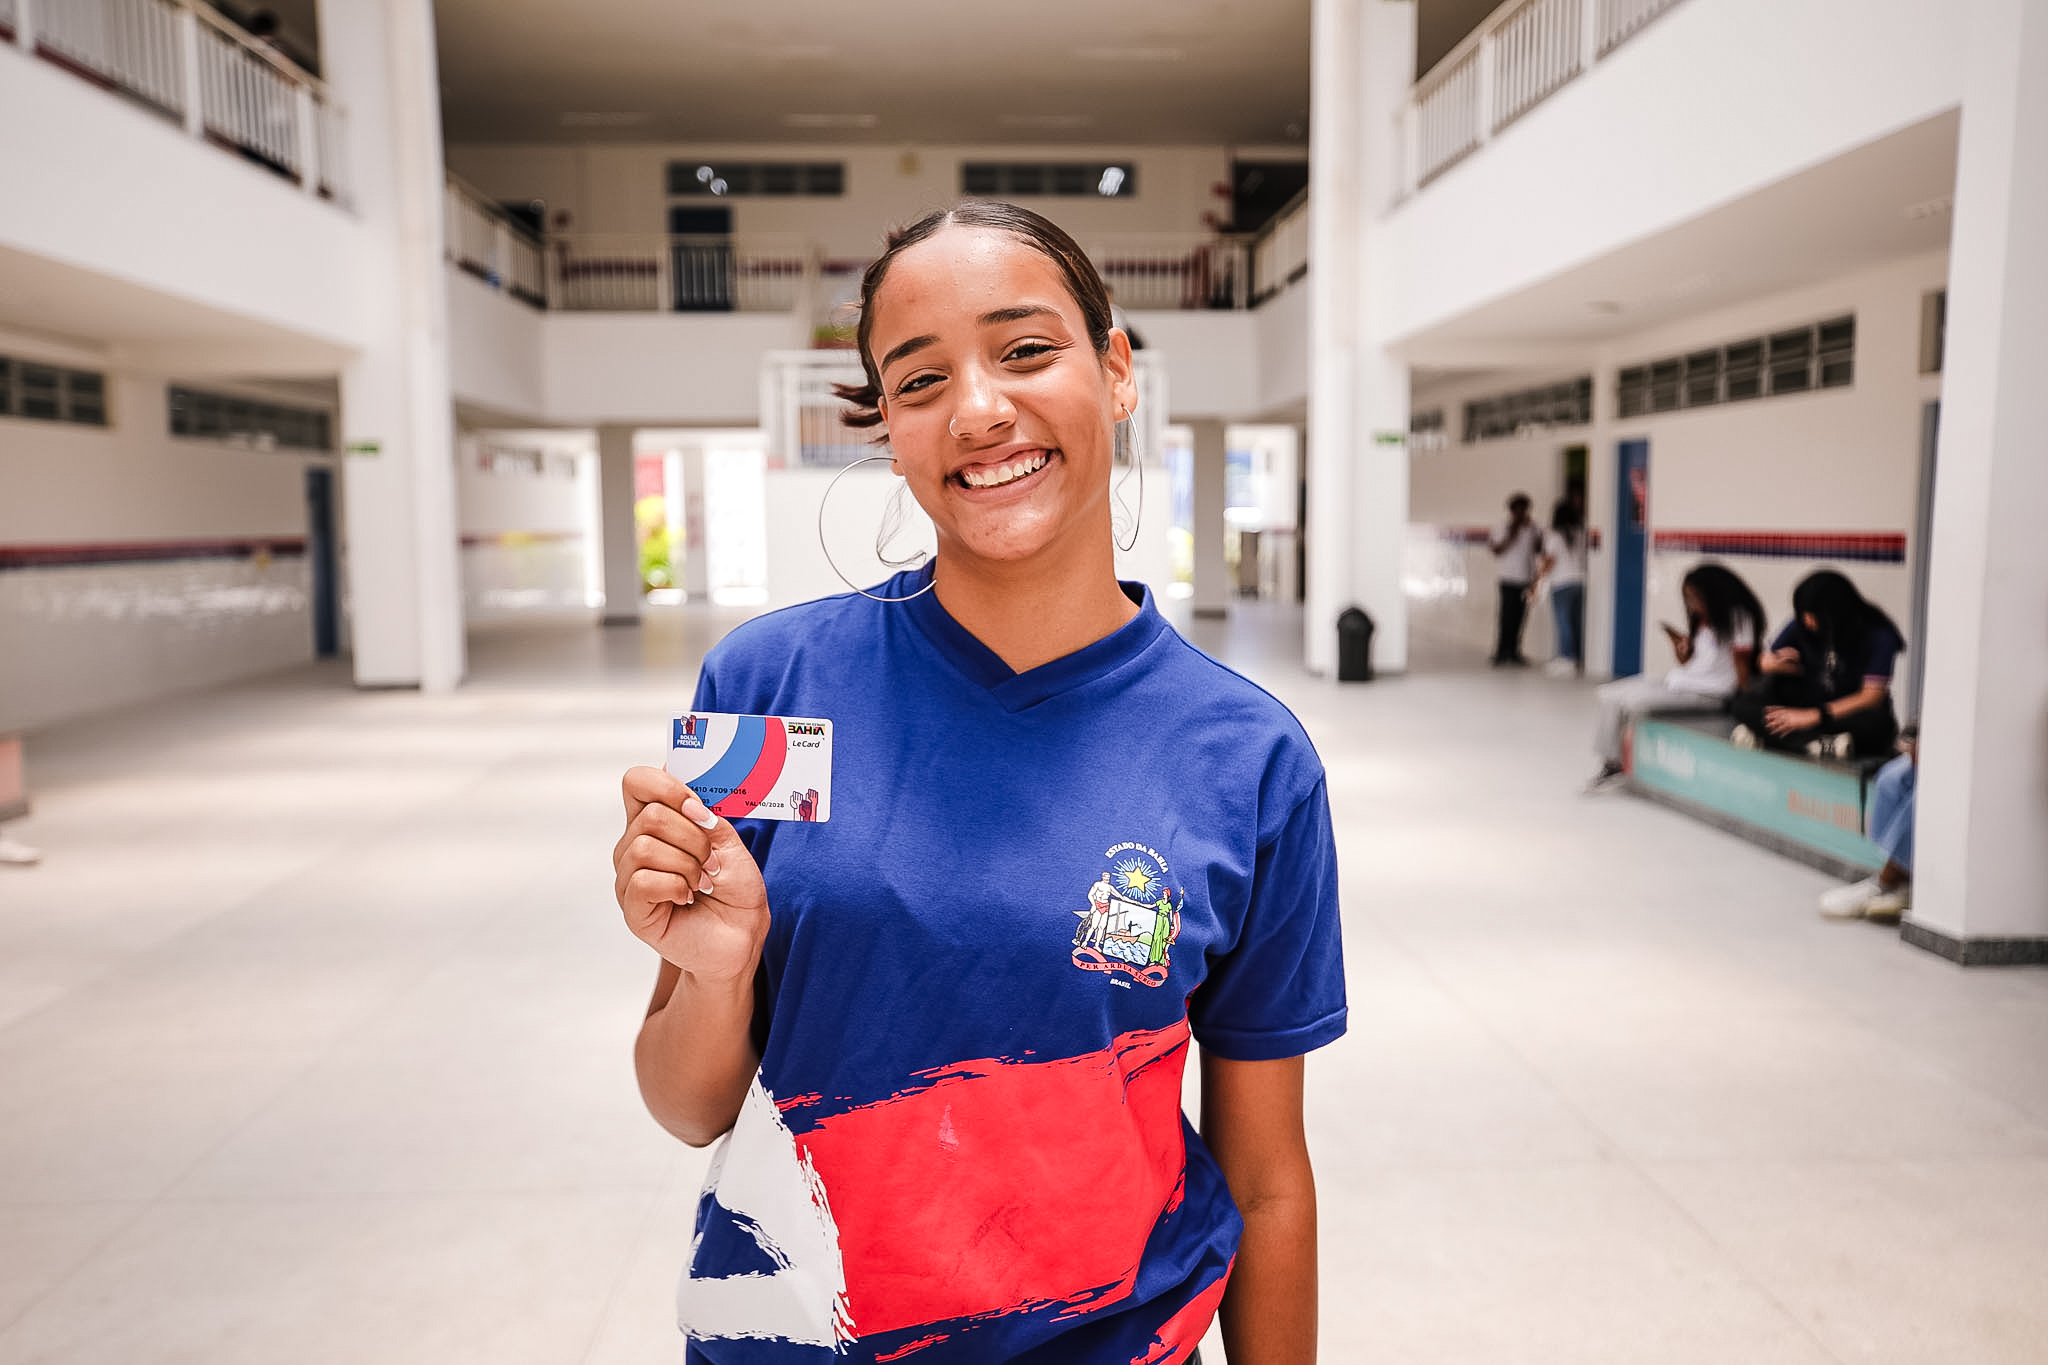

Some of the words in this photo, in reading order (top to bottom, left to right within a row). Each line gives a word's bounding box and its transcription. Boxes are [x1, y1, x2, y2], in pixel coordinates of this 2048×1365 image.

[788, 725, 825, 736] BAHIA
[677, 739, 702, 748] PRESENÇA
[1104, 841, 1135, 859] ESTADO
[1135, 842, 1148, 853] DA
[1147, 847, 1169, 874] BAHIA
[1080, 962, 1099, 970] PER
[1134, 971, 1157, 986] SURGO
[1110, 978, 1132, 989] BRASIL
